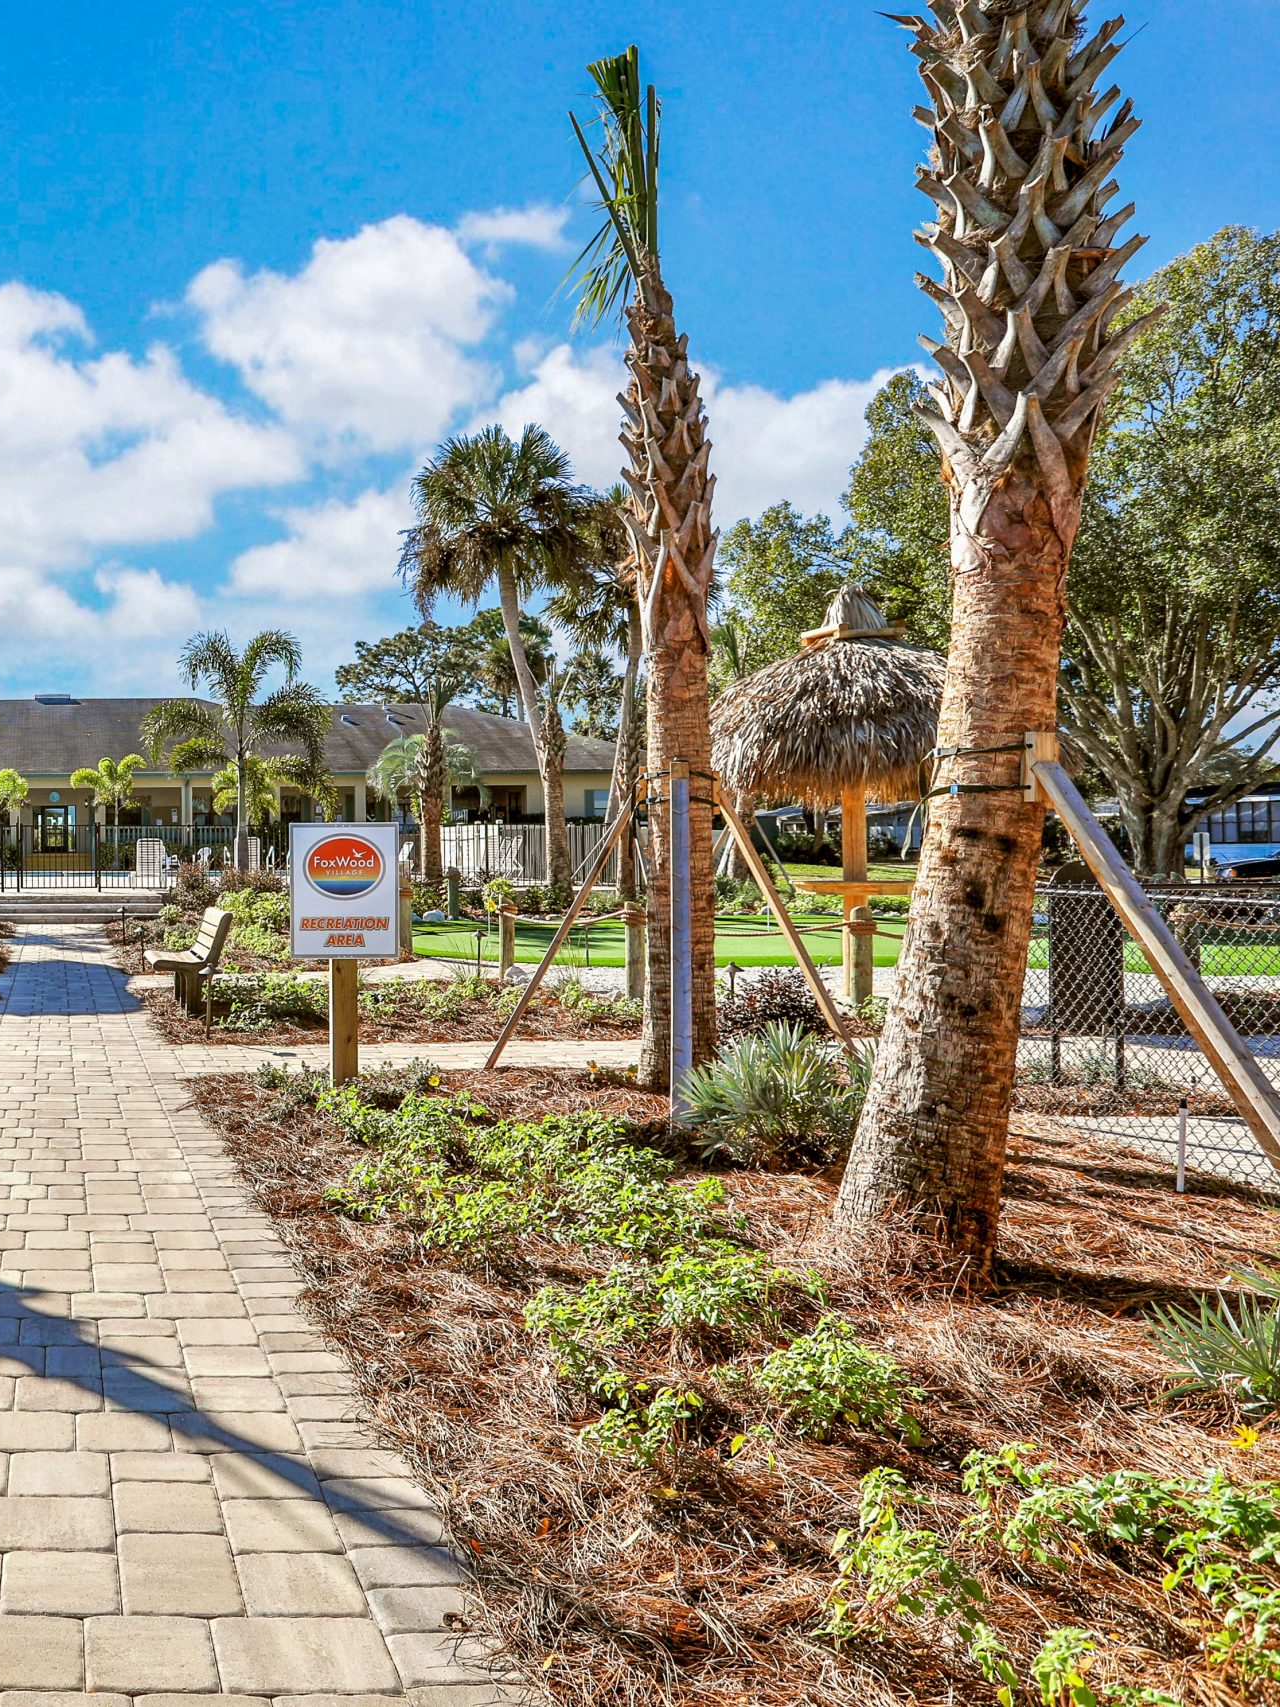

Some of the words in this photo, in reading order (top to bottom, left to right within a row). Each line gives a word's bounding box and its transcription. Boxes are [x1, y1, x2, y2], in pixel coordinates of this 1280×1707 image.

[313, 855, 375, 868] FoxWood
[300, 916, 390, 931] RECREATION
[324, 933, 366, 947] AREA
